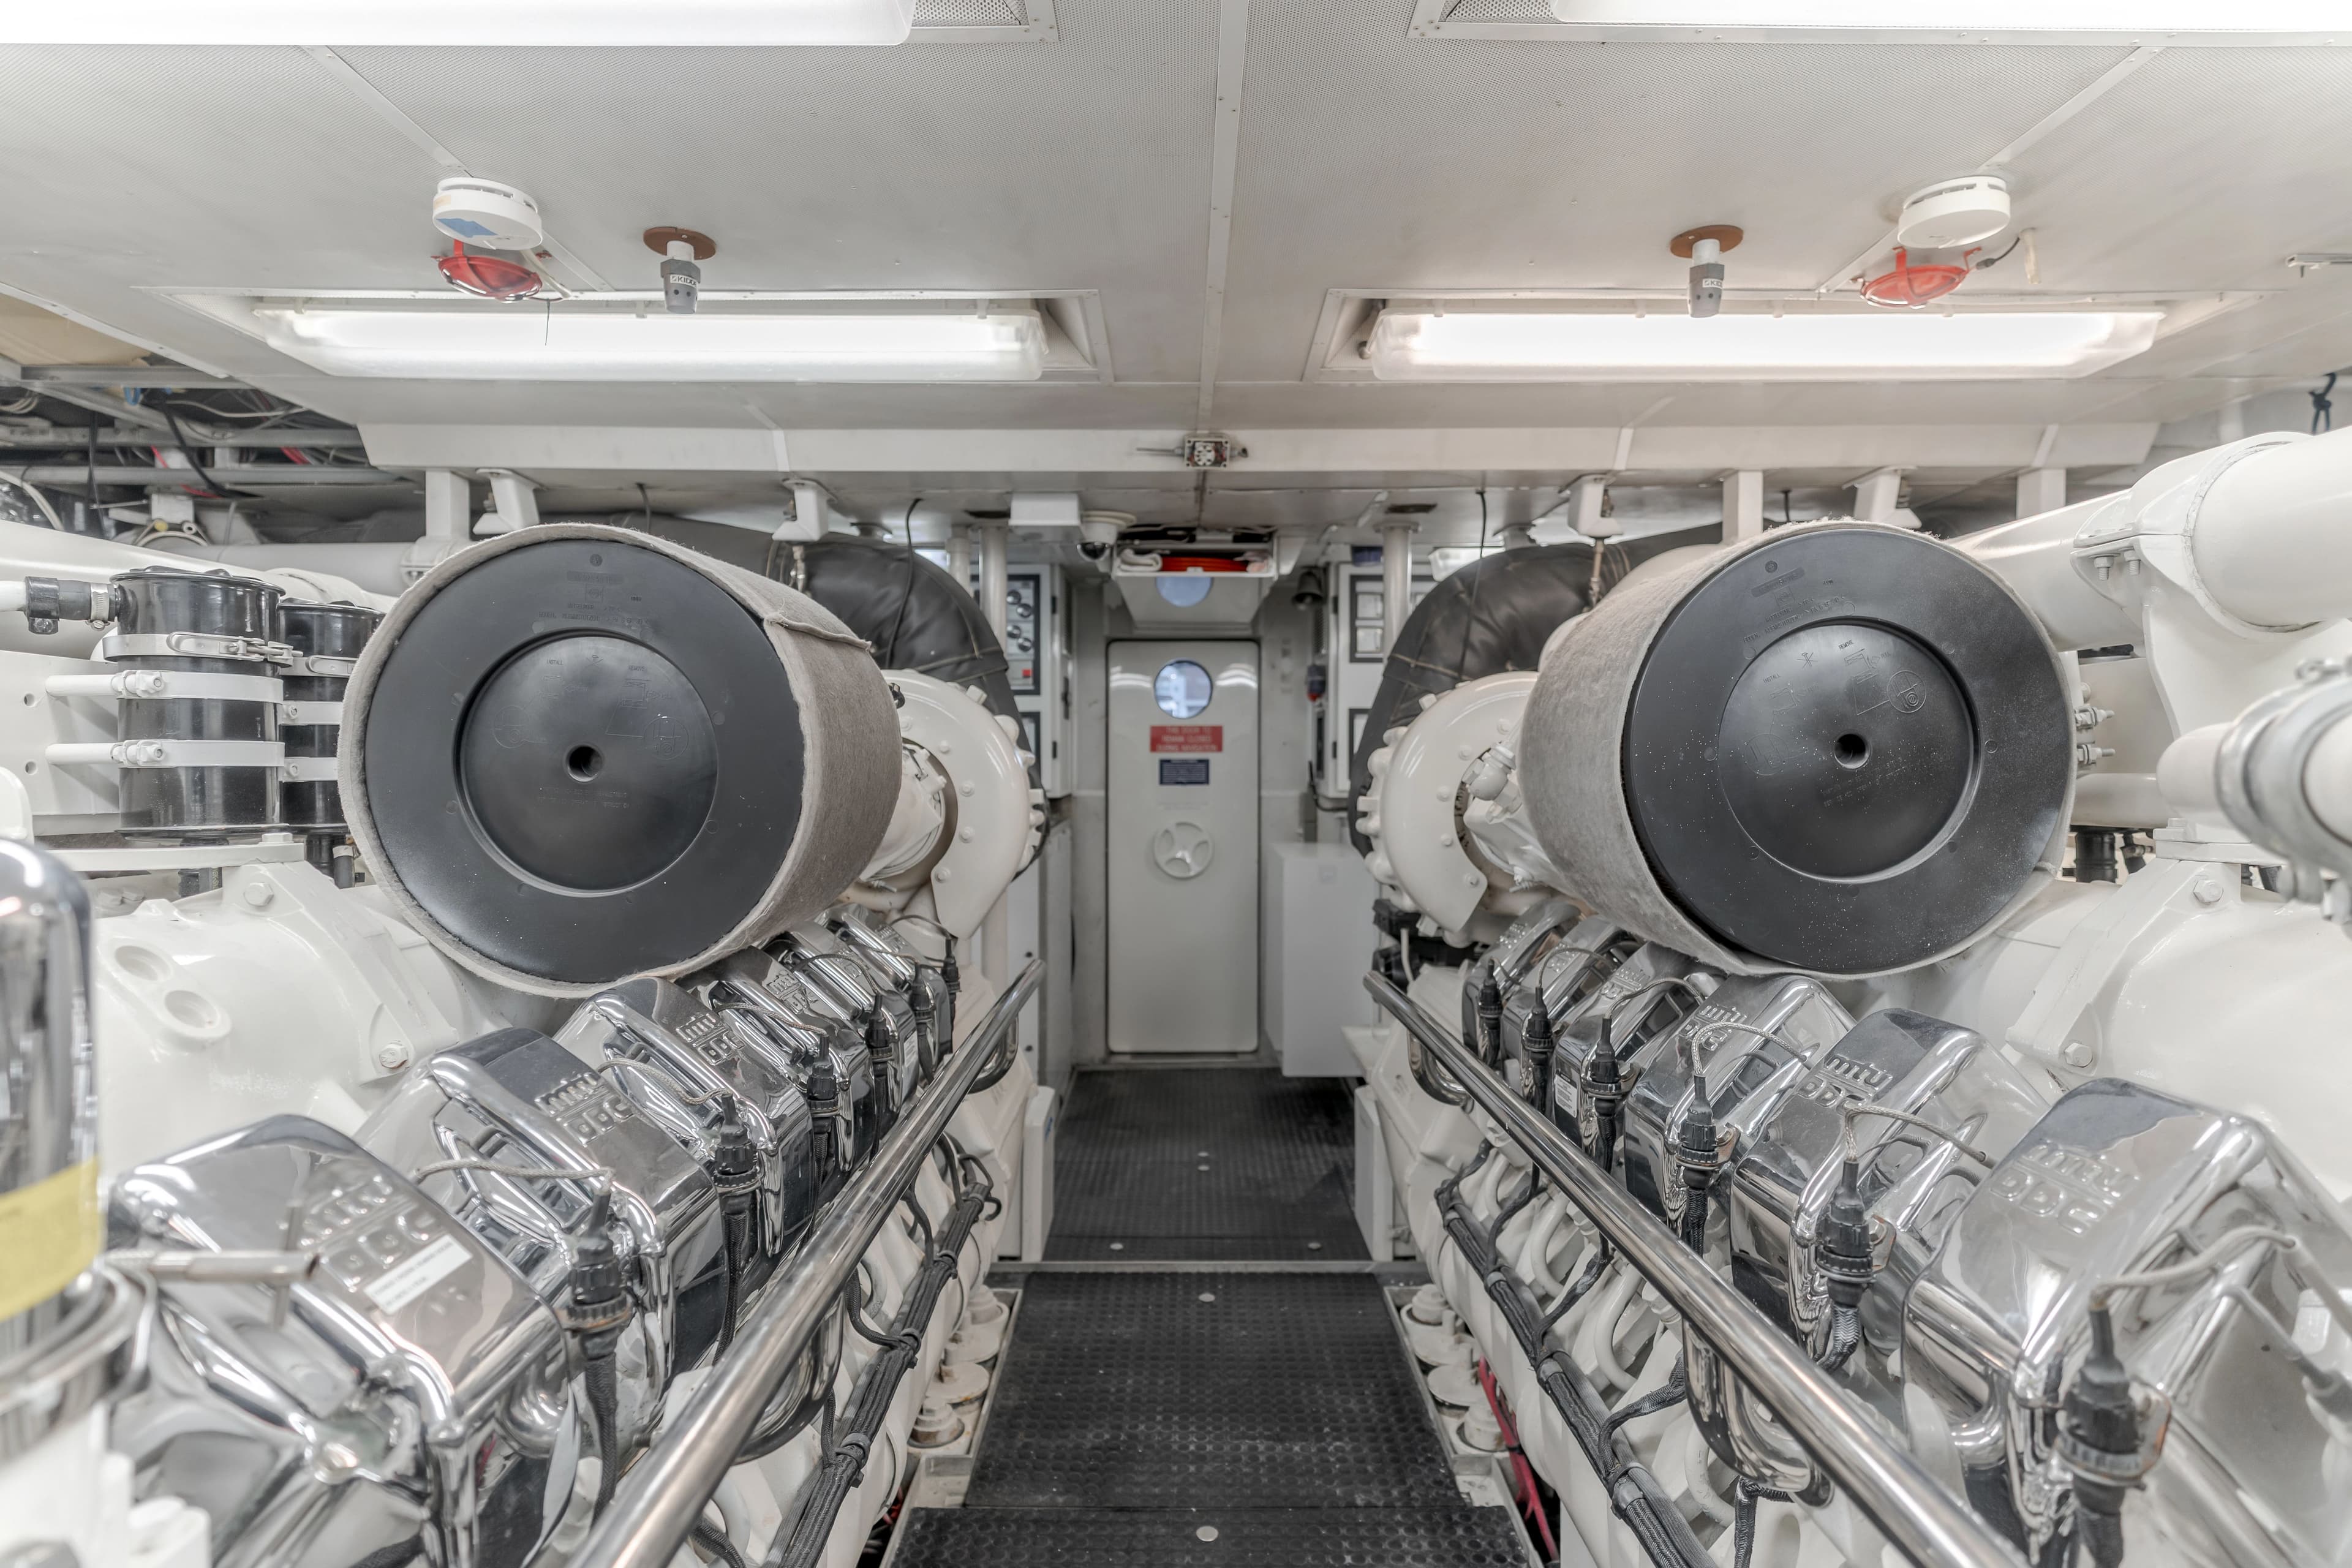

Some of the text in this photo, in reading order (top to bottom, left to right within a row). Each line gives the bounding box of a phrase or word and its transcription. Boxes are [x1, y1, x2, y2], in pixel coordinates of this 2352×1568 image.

[677, 276, 696, 286] KIDD
[1838, 639, 1854, 650] REMOVE
[1763, 672, 1781, 683] INSTALL
[676, 1012, 723, 1042] mtu
[698, 1029, 746, 1066] DDC
[1824, 1054, 1893, 1092] mtu
[534, 1071, 604, 1117] mtu
[563, 1094, 636, 1149] DDC
[2021, 1140, 2141, 1200] mtu
[1990, 1166, 2108, 1237] DDC
[318, 1207, 446, 1294] DDC
